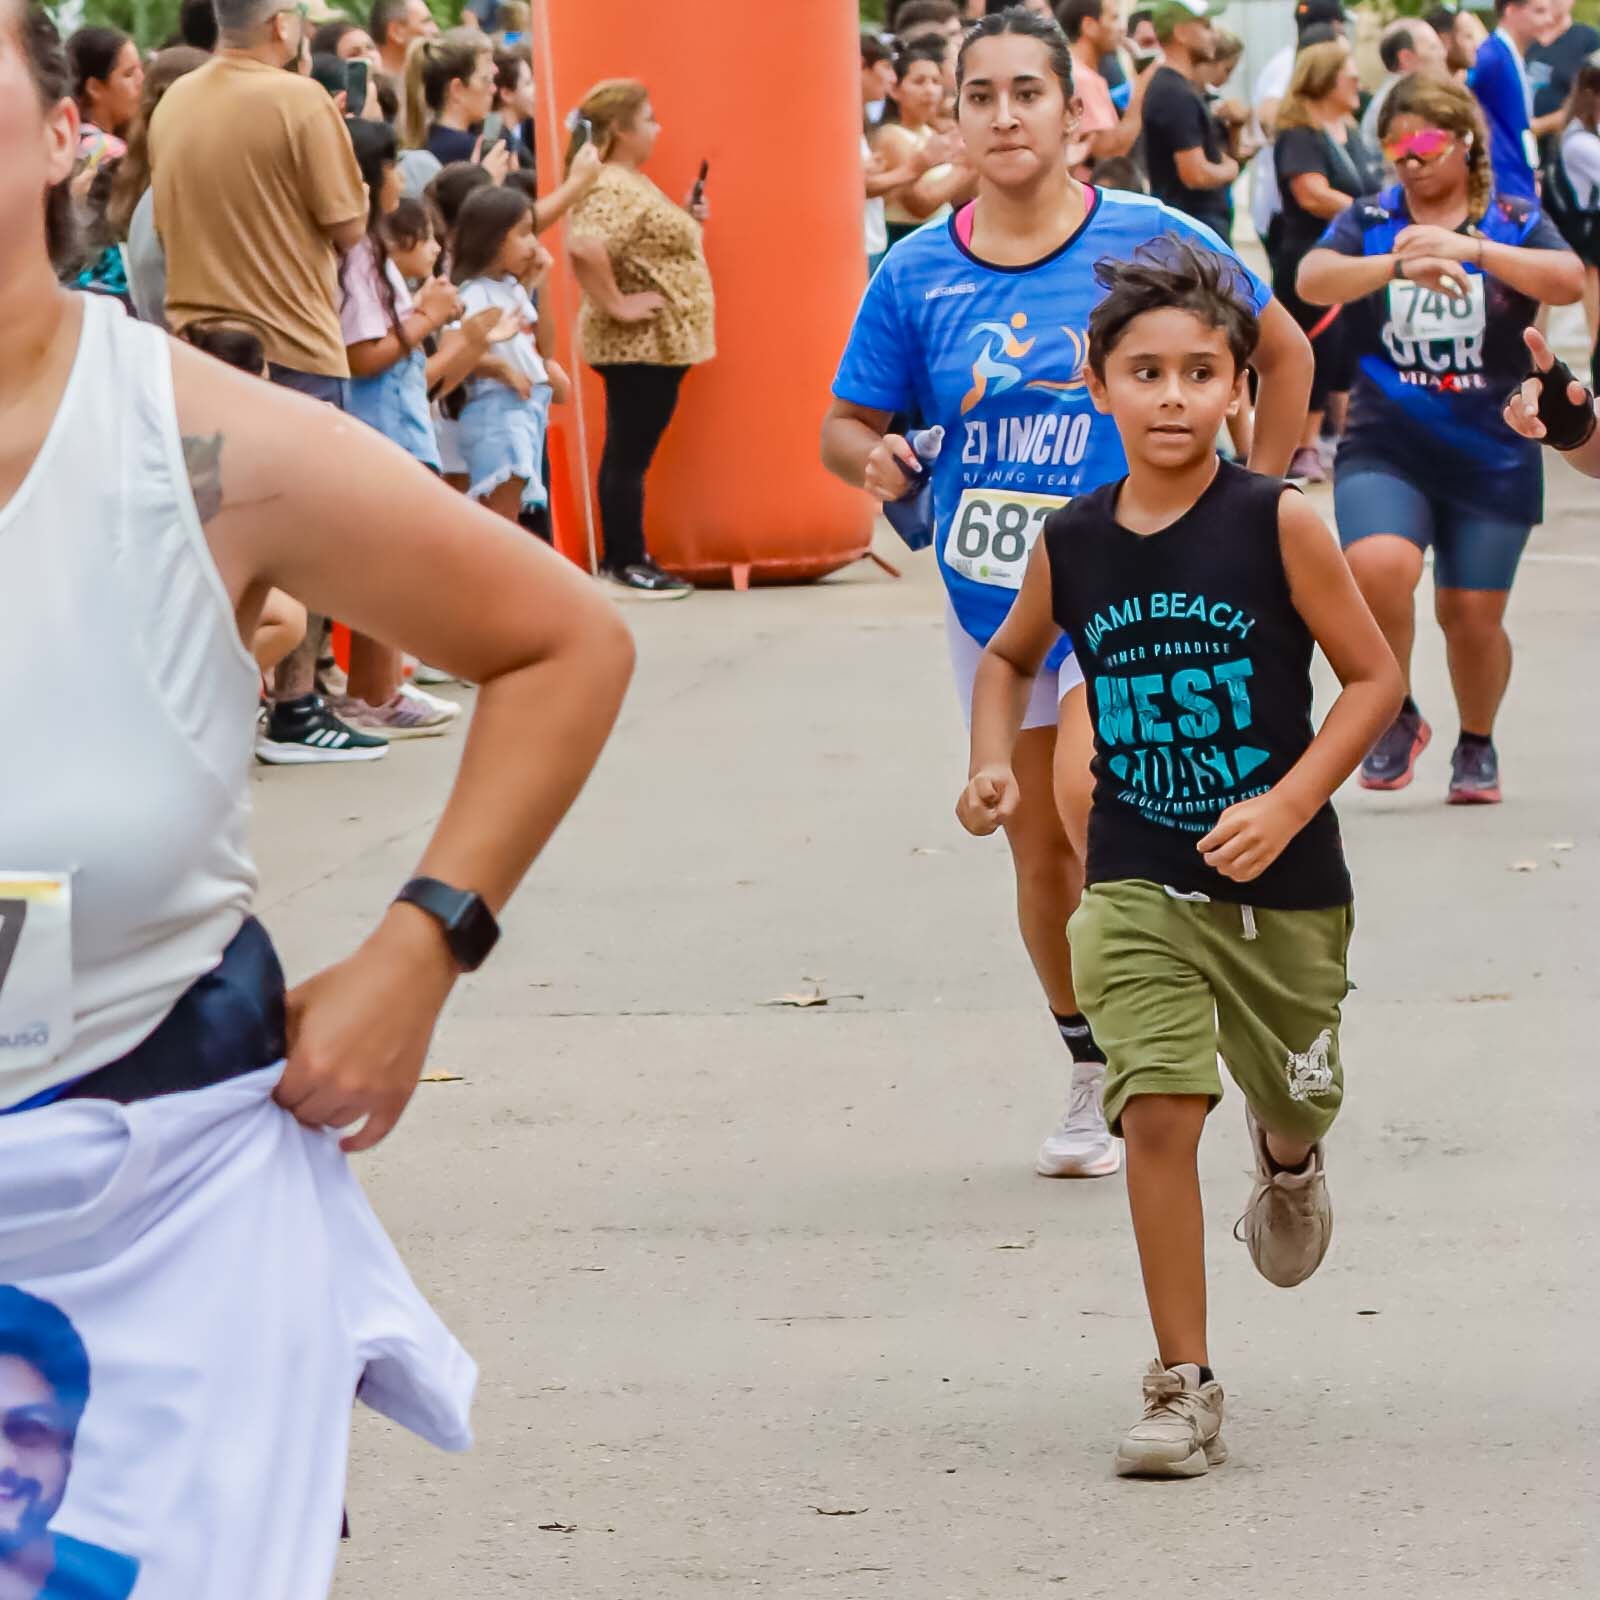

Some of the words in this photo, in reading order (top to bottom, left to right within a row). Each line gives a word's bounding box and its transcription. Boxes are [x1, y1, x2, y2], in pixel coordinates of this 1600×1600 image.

[1037, 473, 1081, 487] TEAM
[957, 499, 1058, 563] 68
[1150, 592, 1256, 640] BEACH
[1154, 642, 1231, 657] PARADISE
[1094, 657, 1254, 747] WEST
